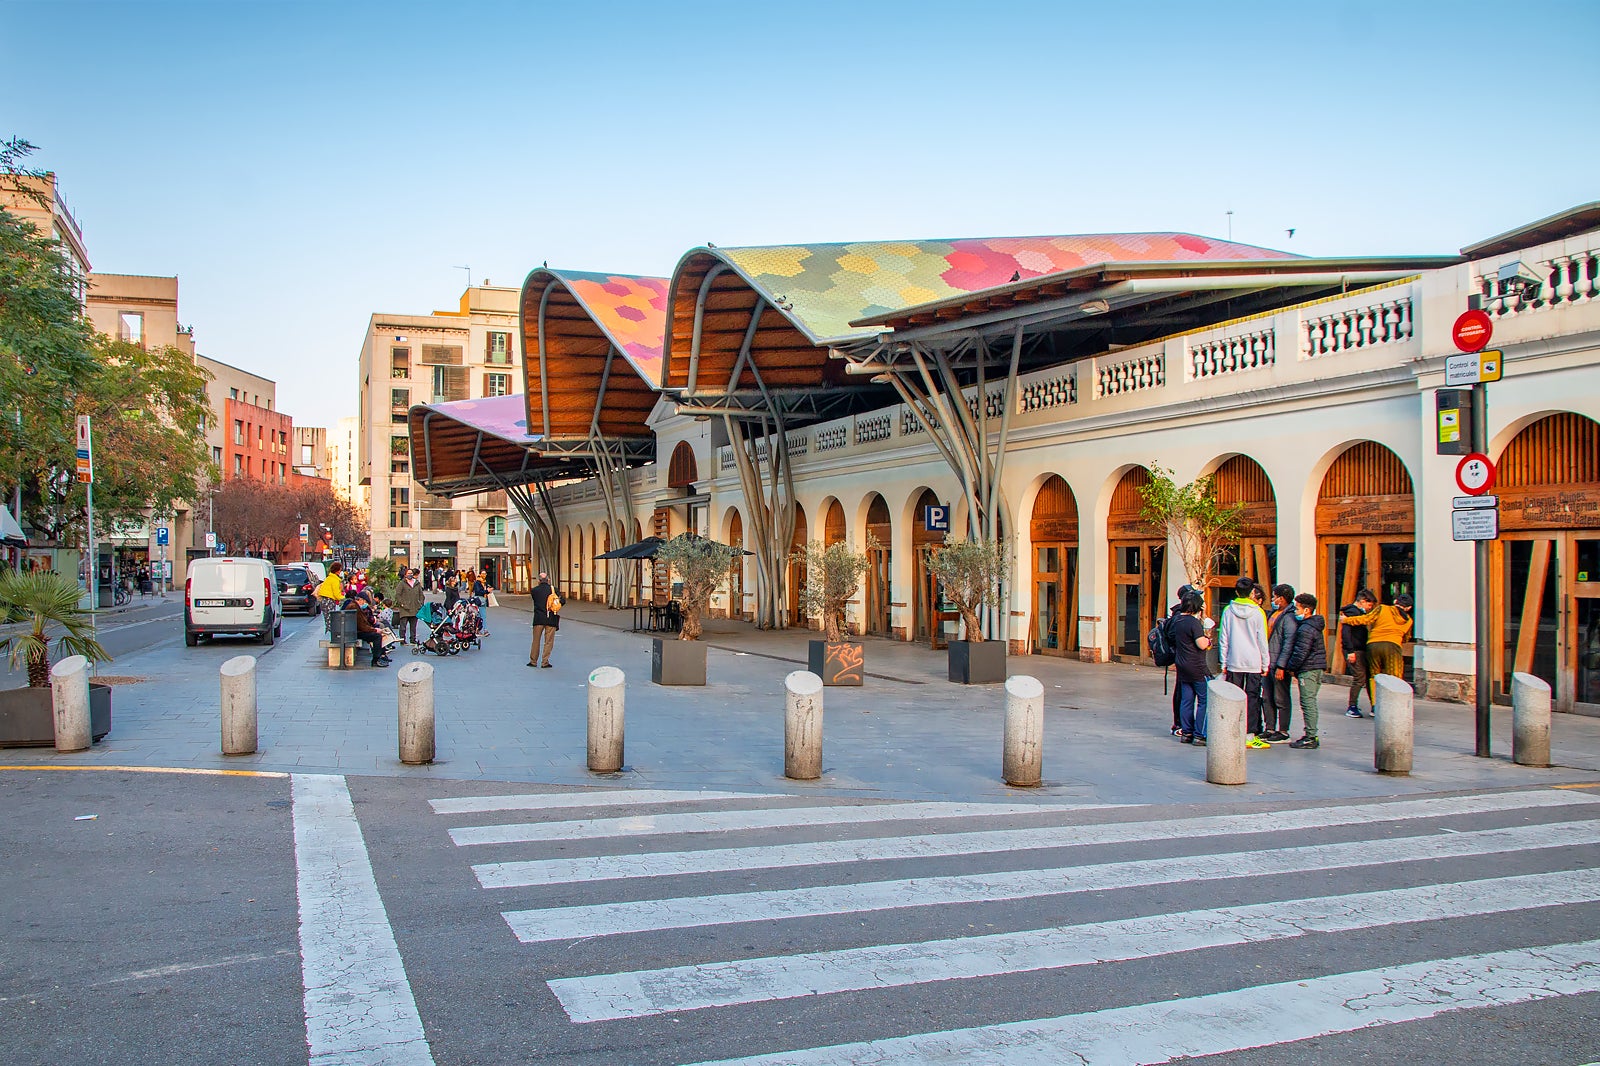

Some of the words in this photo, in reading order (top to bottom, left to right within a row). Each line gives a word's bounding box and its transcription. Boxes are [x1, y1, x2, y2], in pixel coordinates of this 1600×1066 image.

[1502, 500, 1522, 511] Santa
[1524, 496, 1556, 508] Caterina
[931, 507, 944, 526] P
[1549, 512, 1572, 523] Santa
[159, 529, 166, 538] P
